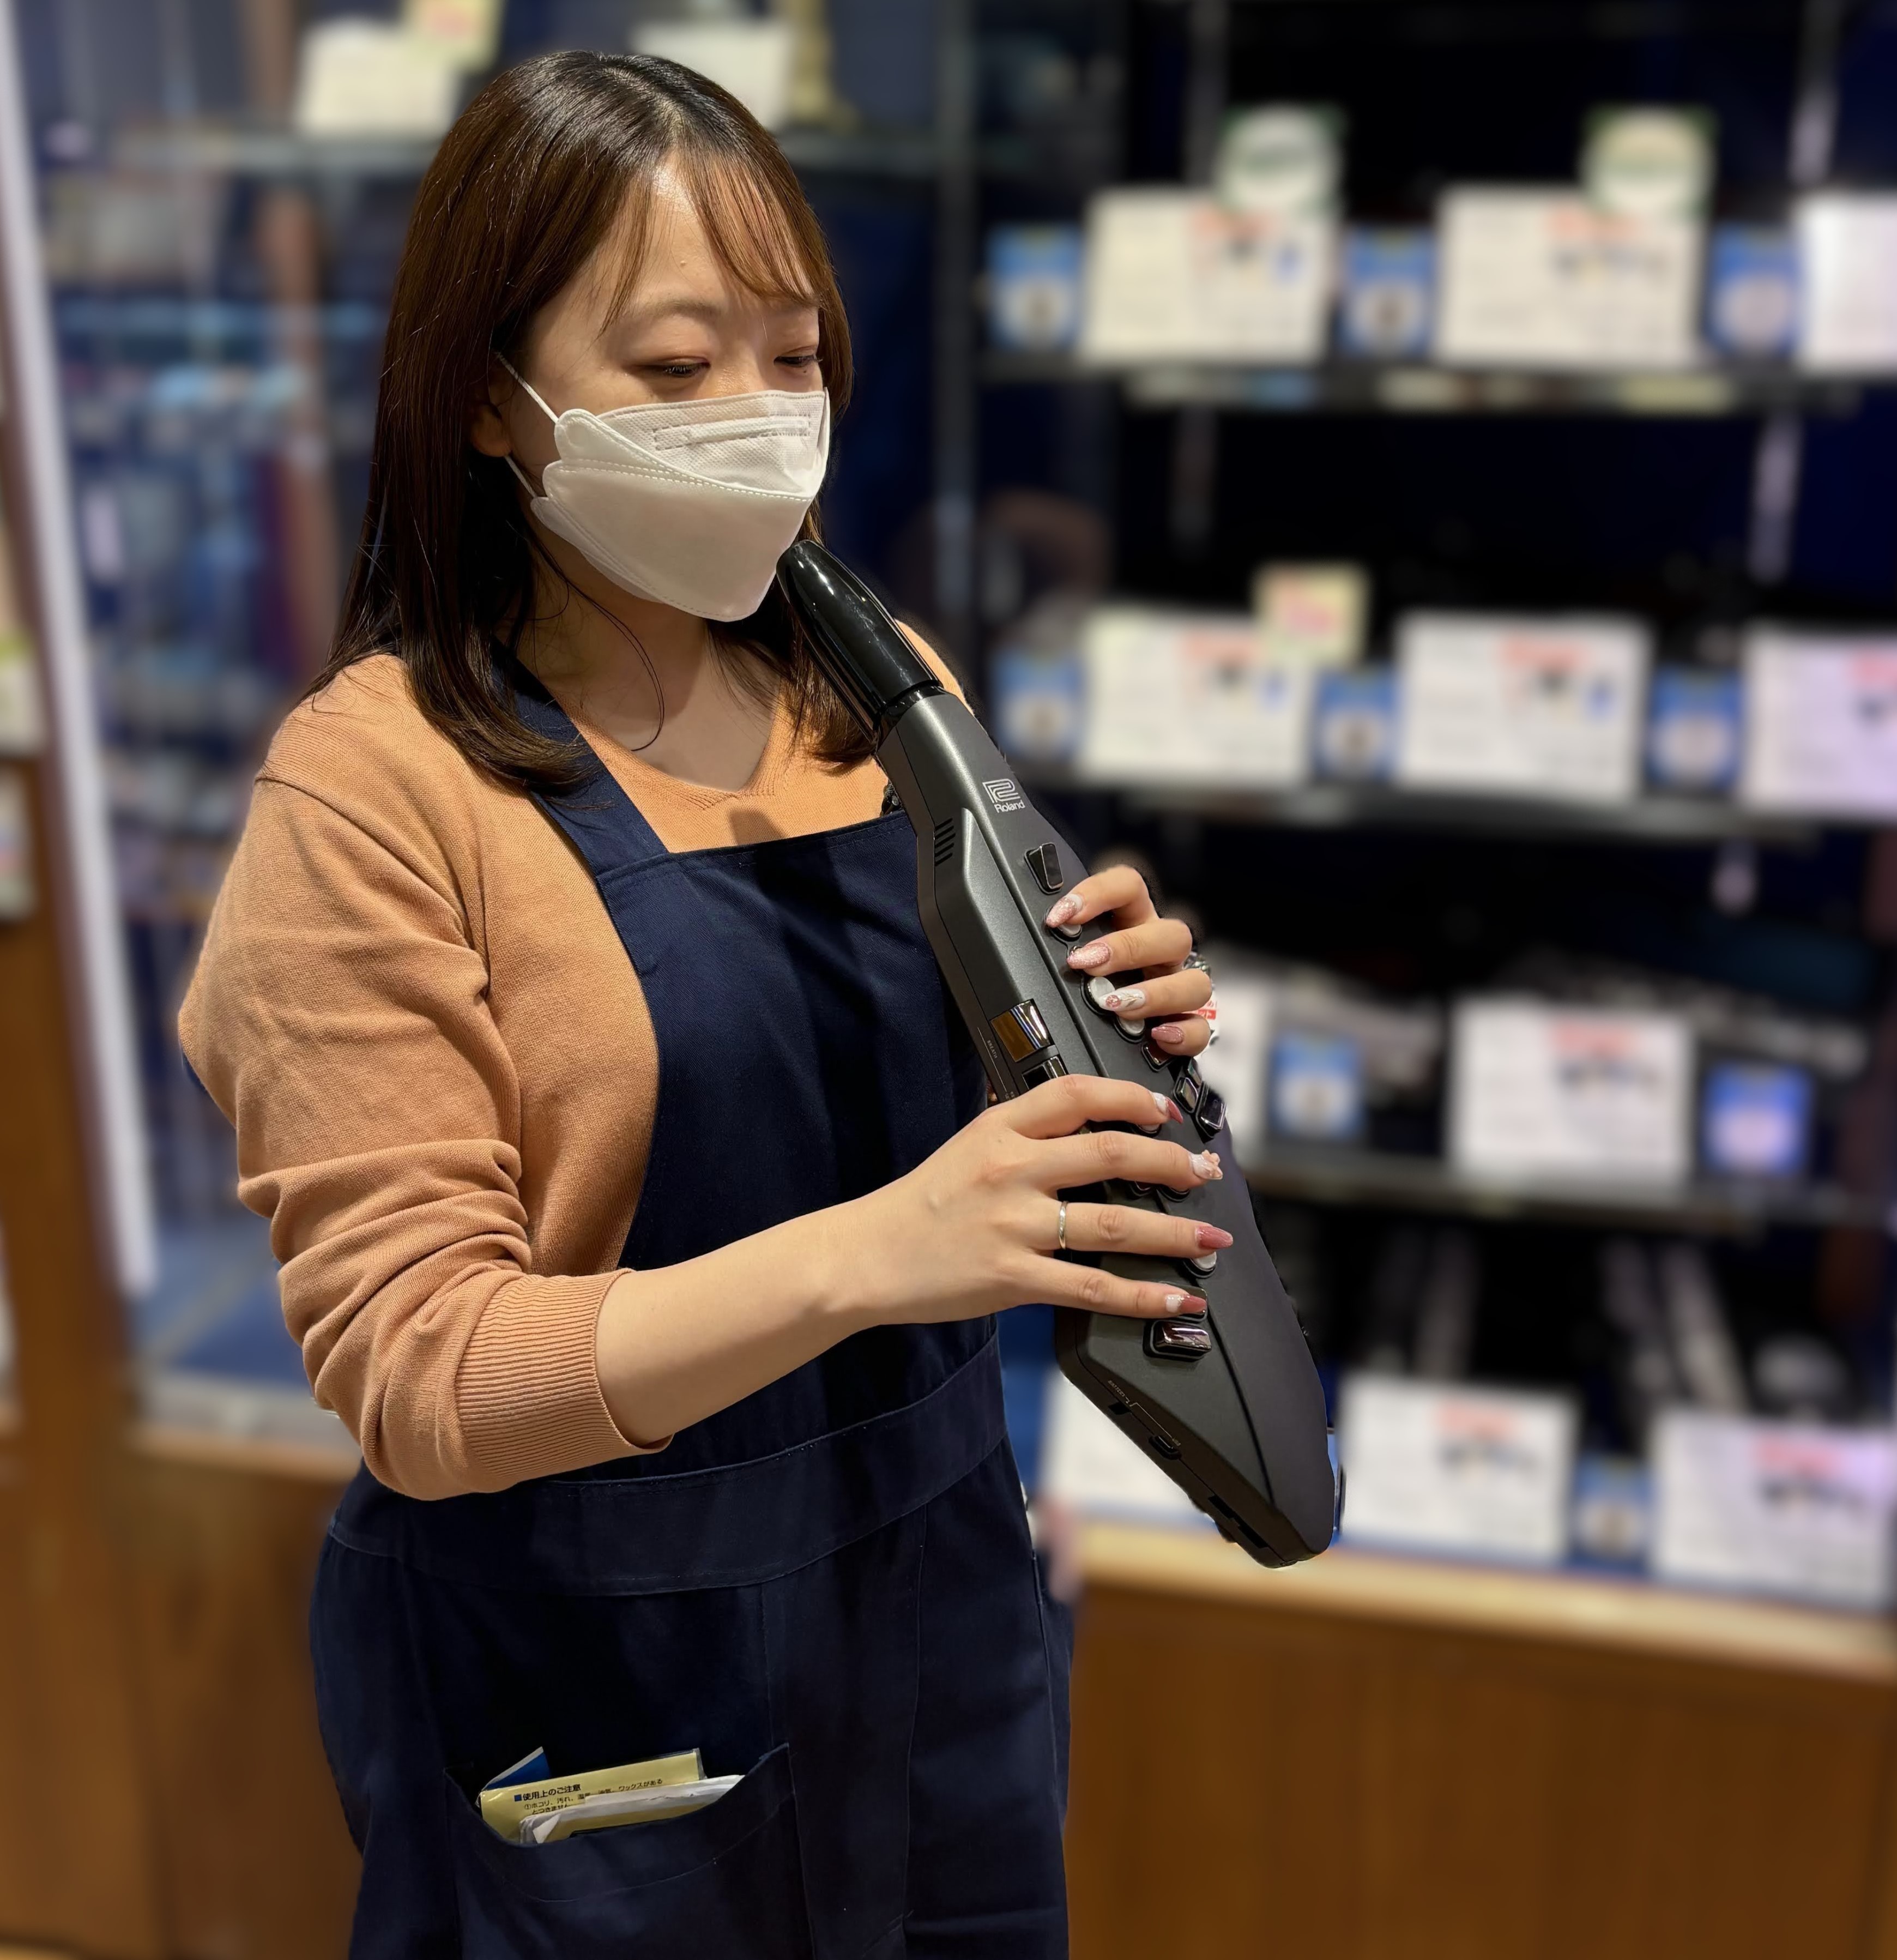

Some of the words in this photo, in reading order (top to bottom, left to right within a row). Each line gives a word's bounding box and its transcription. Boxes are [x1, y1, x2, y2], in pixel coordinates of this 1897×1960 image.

[994, 799, 1025, 813] Roland
[523, 1783, 581, 1801] 使用上のご注意
